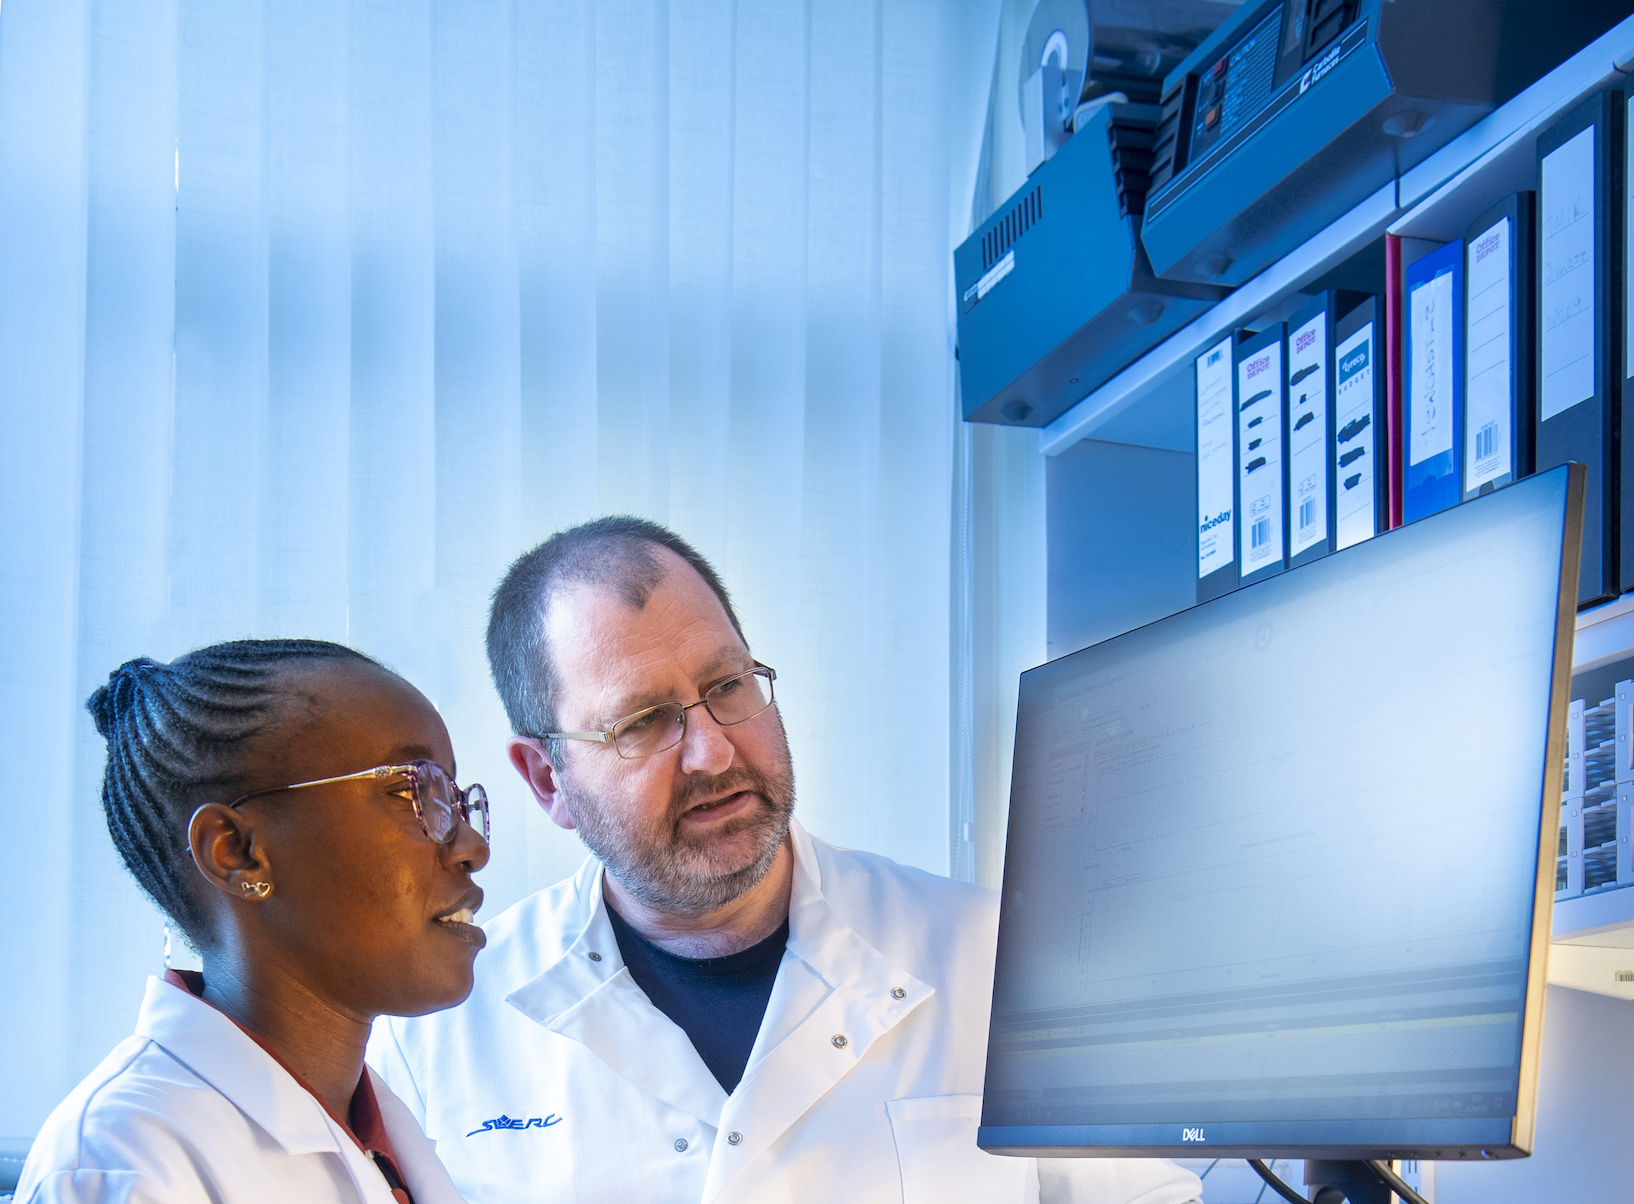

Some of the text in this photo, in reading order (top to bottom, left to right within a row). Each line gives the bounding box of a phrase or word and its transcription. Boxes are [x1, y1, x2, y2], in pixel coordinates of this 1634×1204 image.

[1311, 54, 1340, 86] Furnaces
[1313, 44, 1341, 74] Carbolite
[1475, 232, 1500, 254] Office
[1475, 240, 1500, 264] DEPOT
[1296, 328, 1316, 347] Office
[1296, 335, 1316, 355] DEPOT
[1246, 355, 1270, 373] Office
[1246, 363, 1270, 381] DEPOT
[1338, 367, 1371, 396] BUDGET
[1200, 508, 1232, 534] niceday
[1182, 1127, 1206, 1142] DELL
